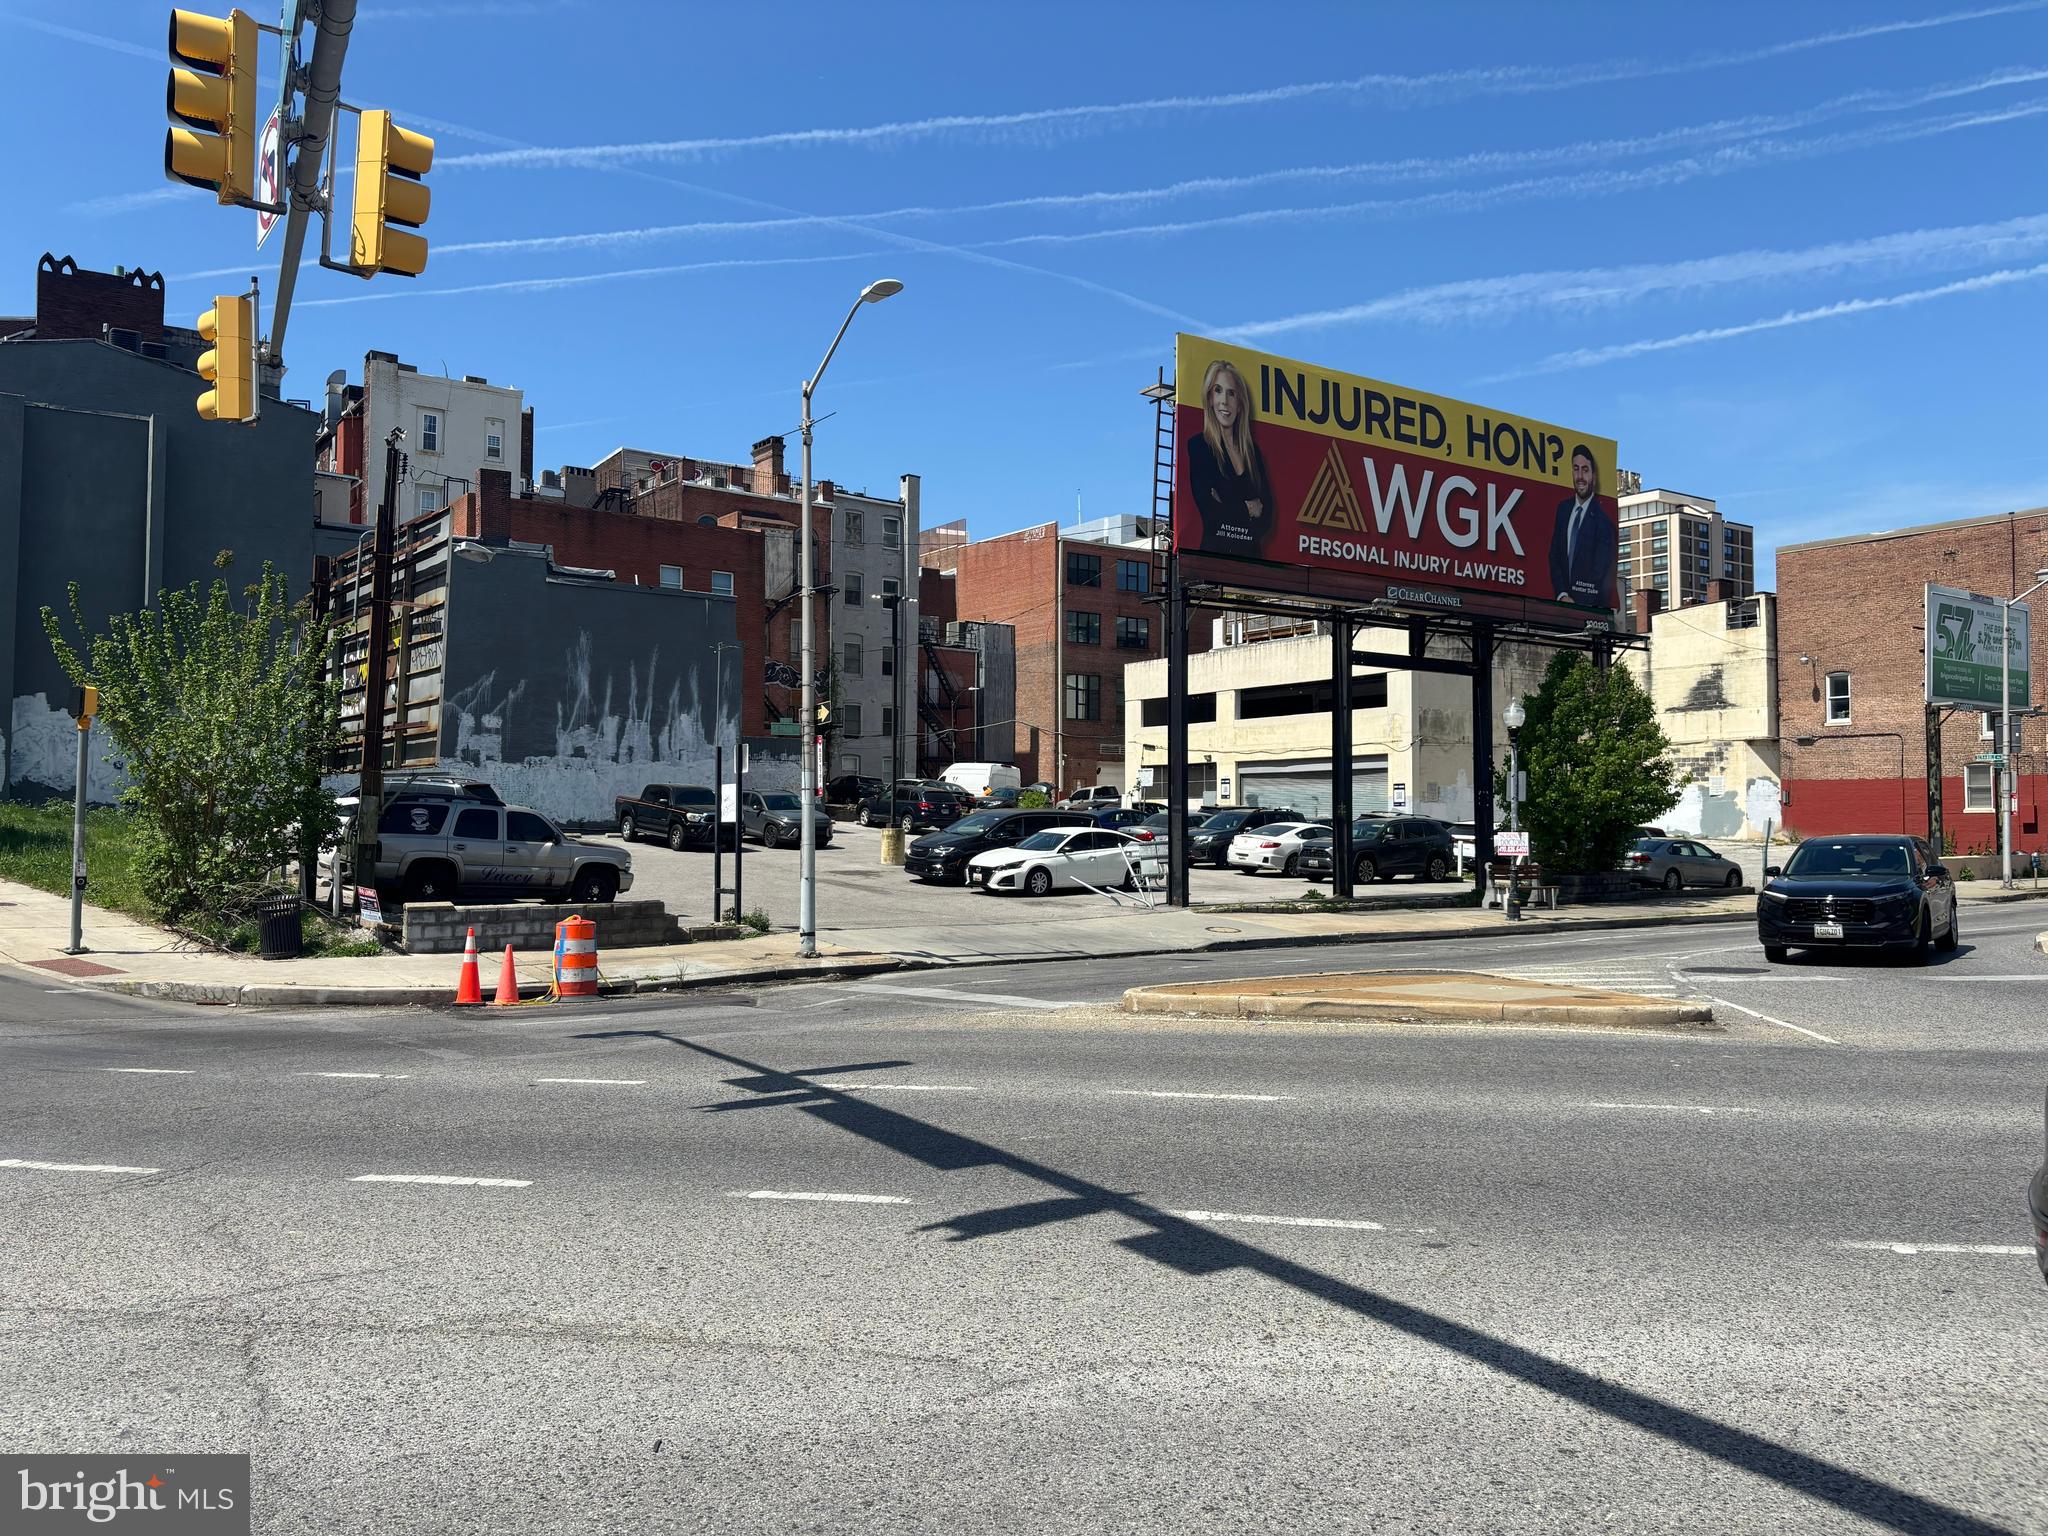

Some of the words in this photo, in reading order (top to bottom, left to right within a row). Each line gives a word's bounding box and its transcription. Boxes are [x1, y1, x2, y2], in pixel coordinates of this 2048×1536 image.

[1261, 364, 1452, 456] INJURED,
[1466, 414, 1564, 476] HON?
[1221, 523, 1249, 534] Attorney
[1362, 456, 1525, 557] WGK
[1299, 534, 1389, 566] PERSONAL
[1394, 550, 1450, 574] INJURY
[1454, 559, 1525, 586] LAWYERS
[1576, 580, 1595, 588] Attorney
